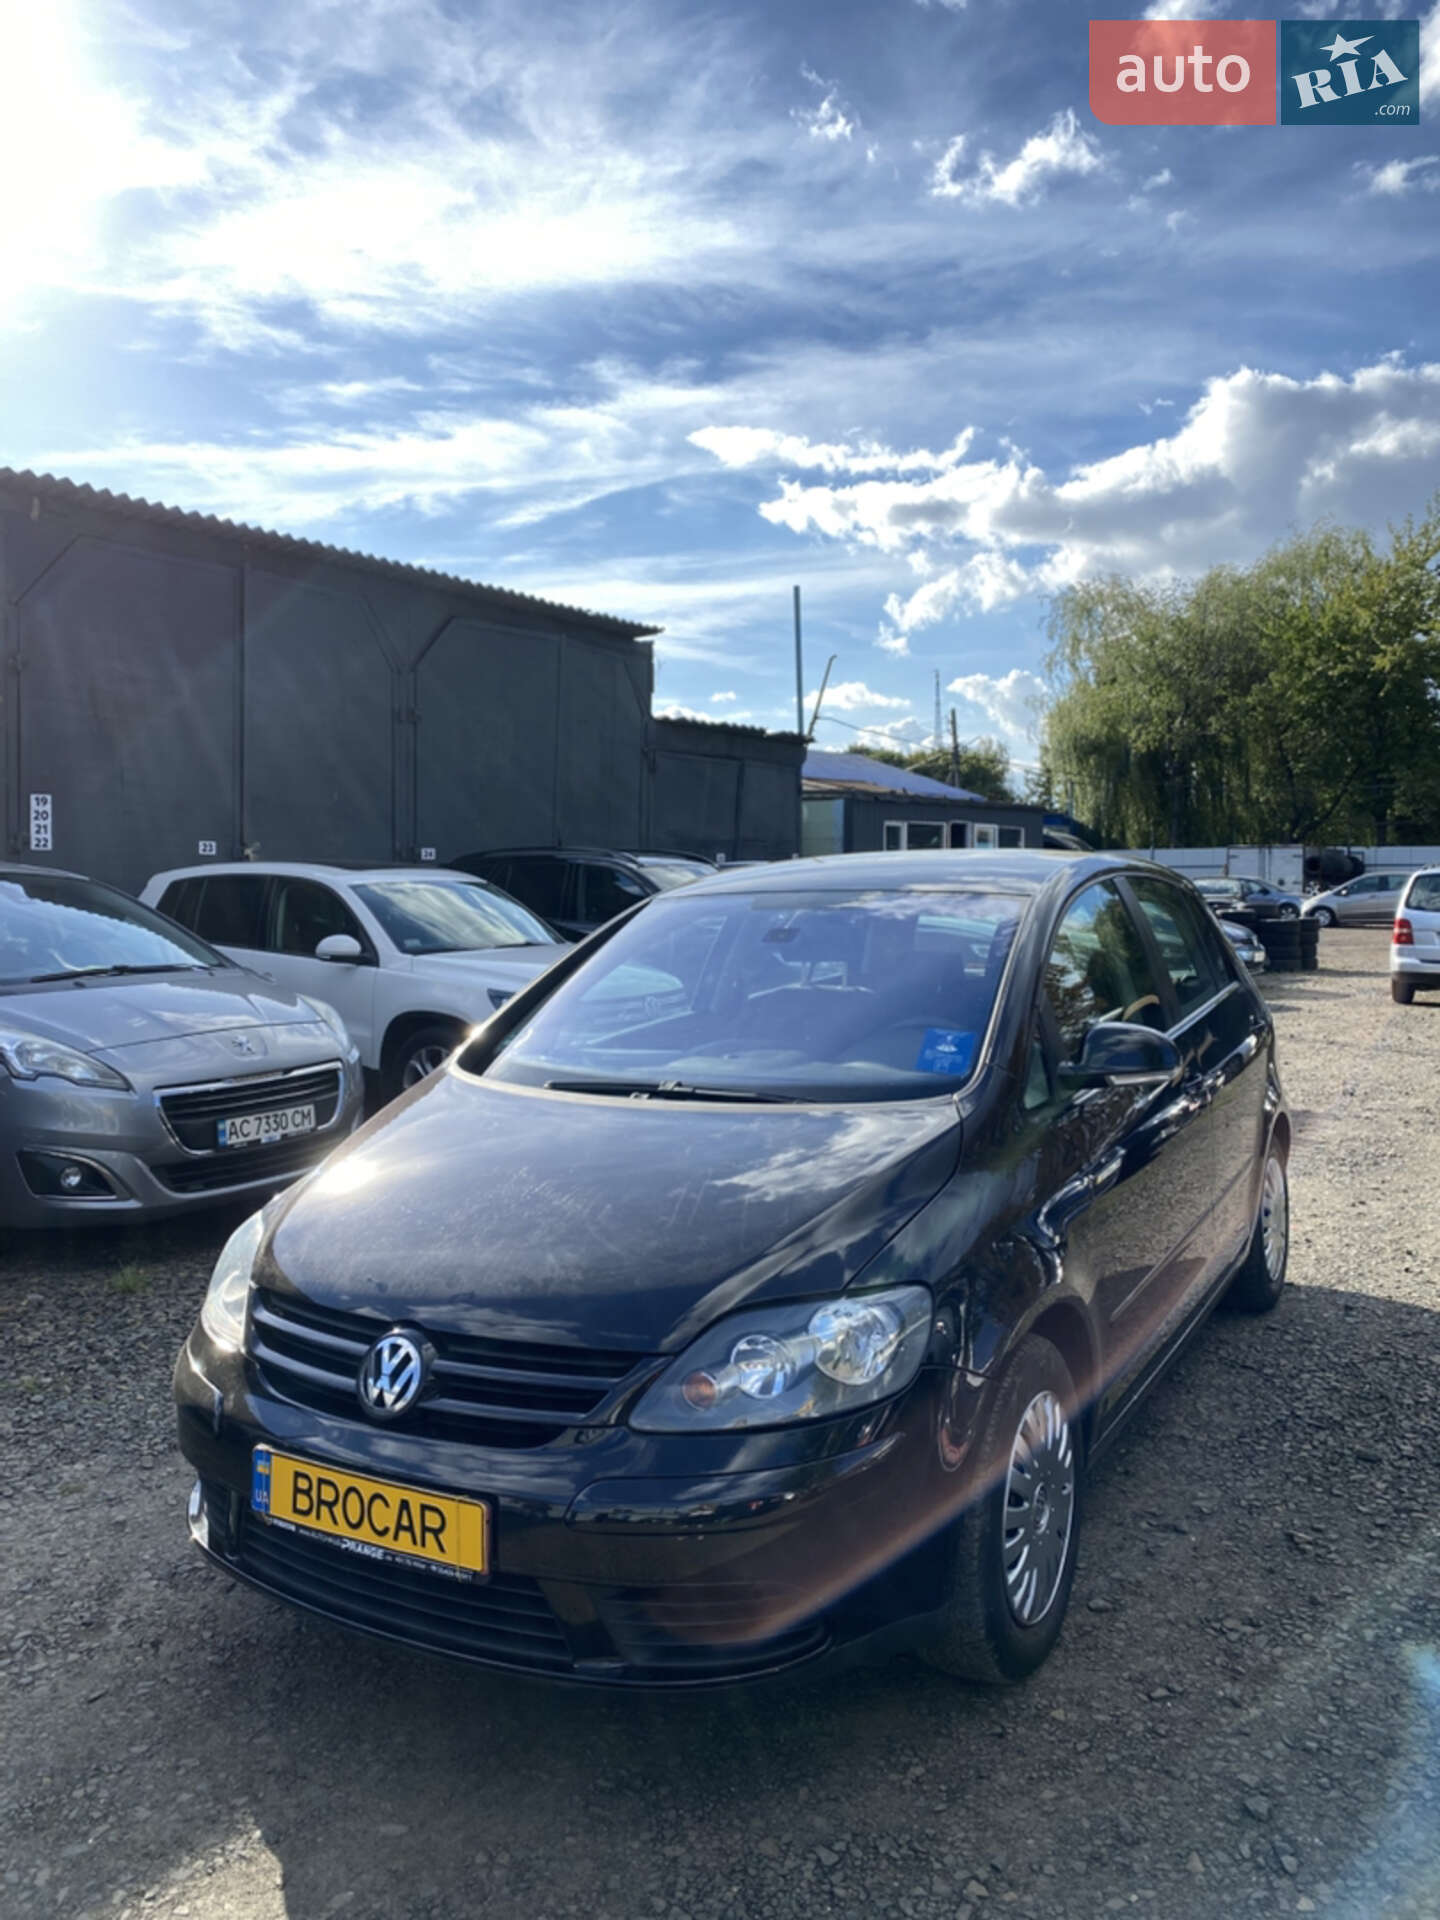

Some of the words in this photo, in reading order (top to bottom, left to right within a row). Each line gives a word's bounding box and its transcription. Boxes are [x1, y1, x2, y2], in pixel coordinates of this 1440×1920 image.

[34, 796, 49, 807] 19
[33, 809, 49, 821] 20
[34, 823, 48, 835] 21
[34, 837, 49, 848] 22
[201, 842, 214, 854] 23
[228, 1119, 251, 1141] AC
[254, 1111, 289, 1136] 7330
[291, 1107, 313, 1128] CM
[292, 1469, 447, 1554] BROCAR
